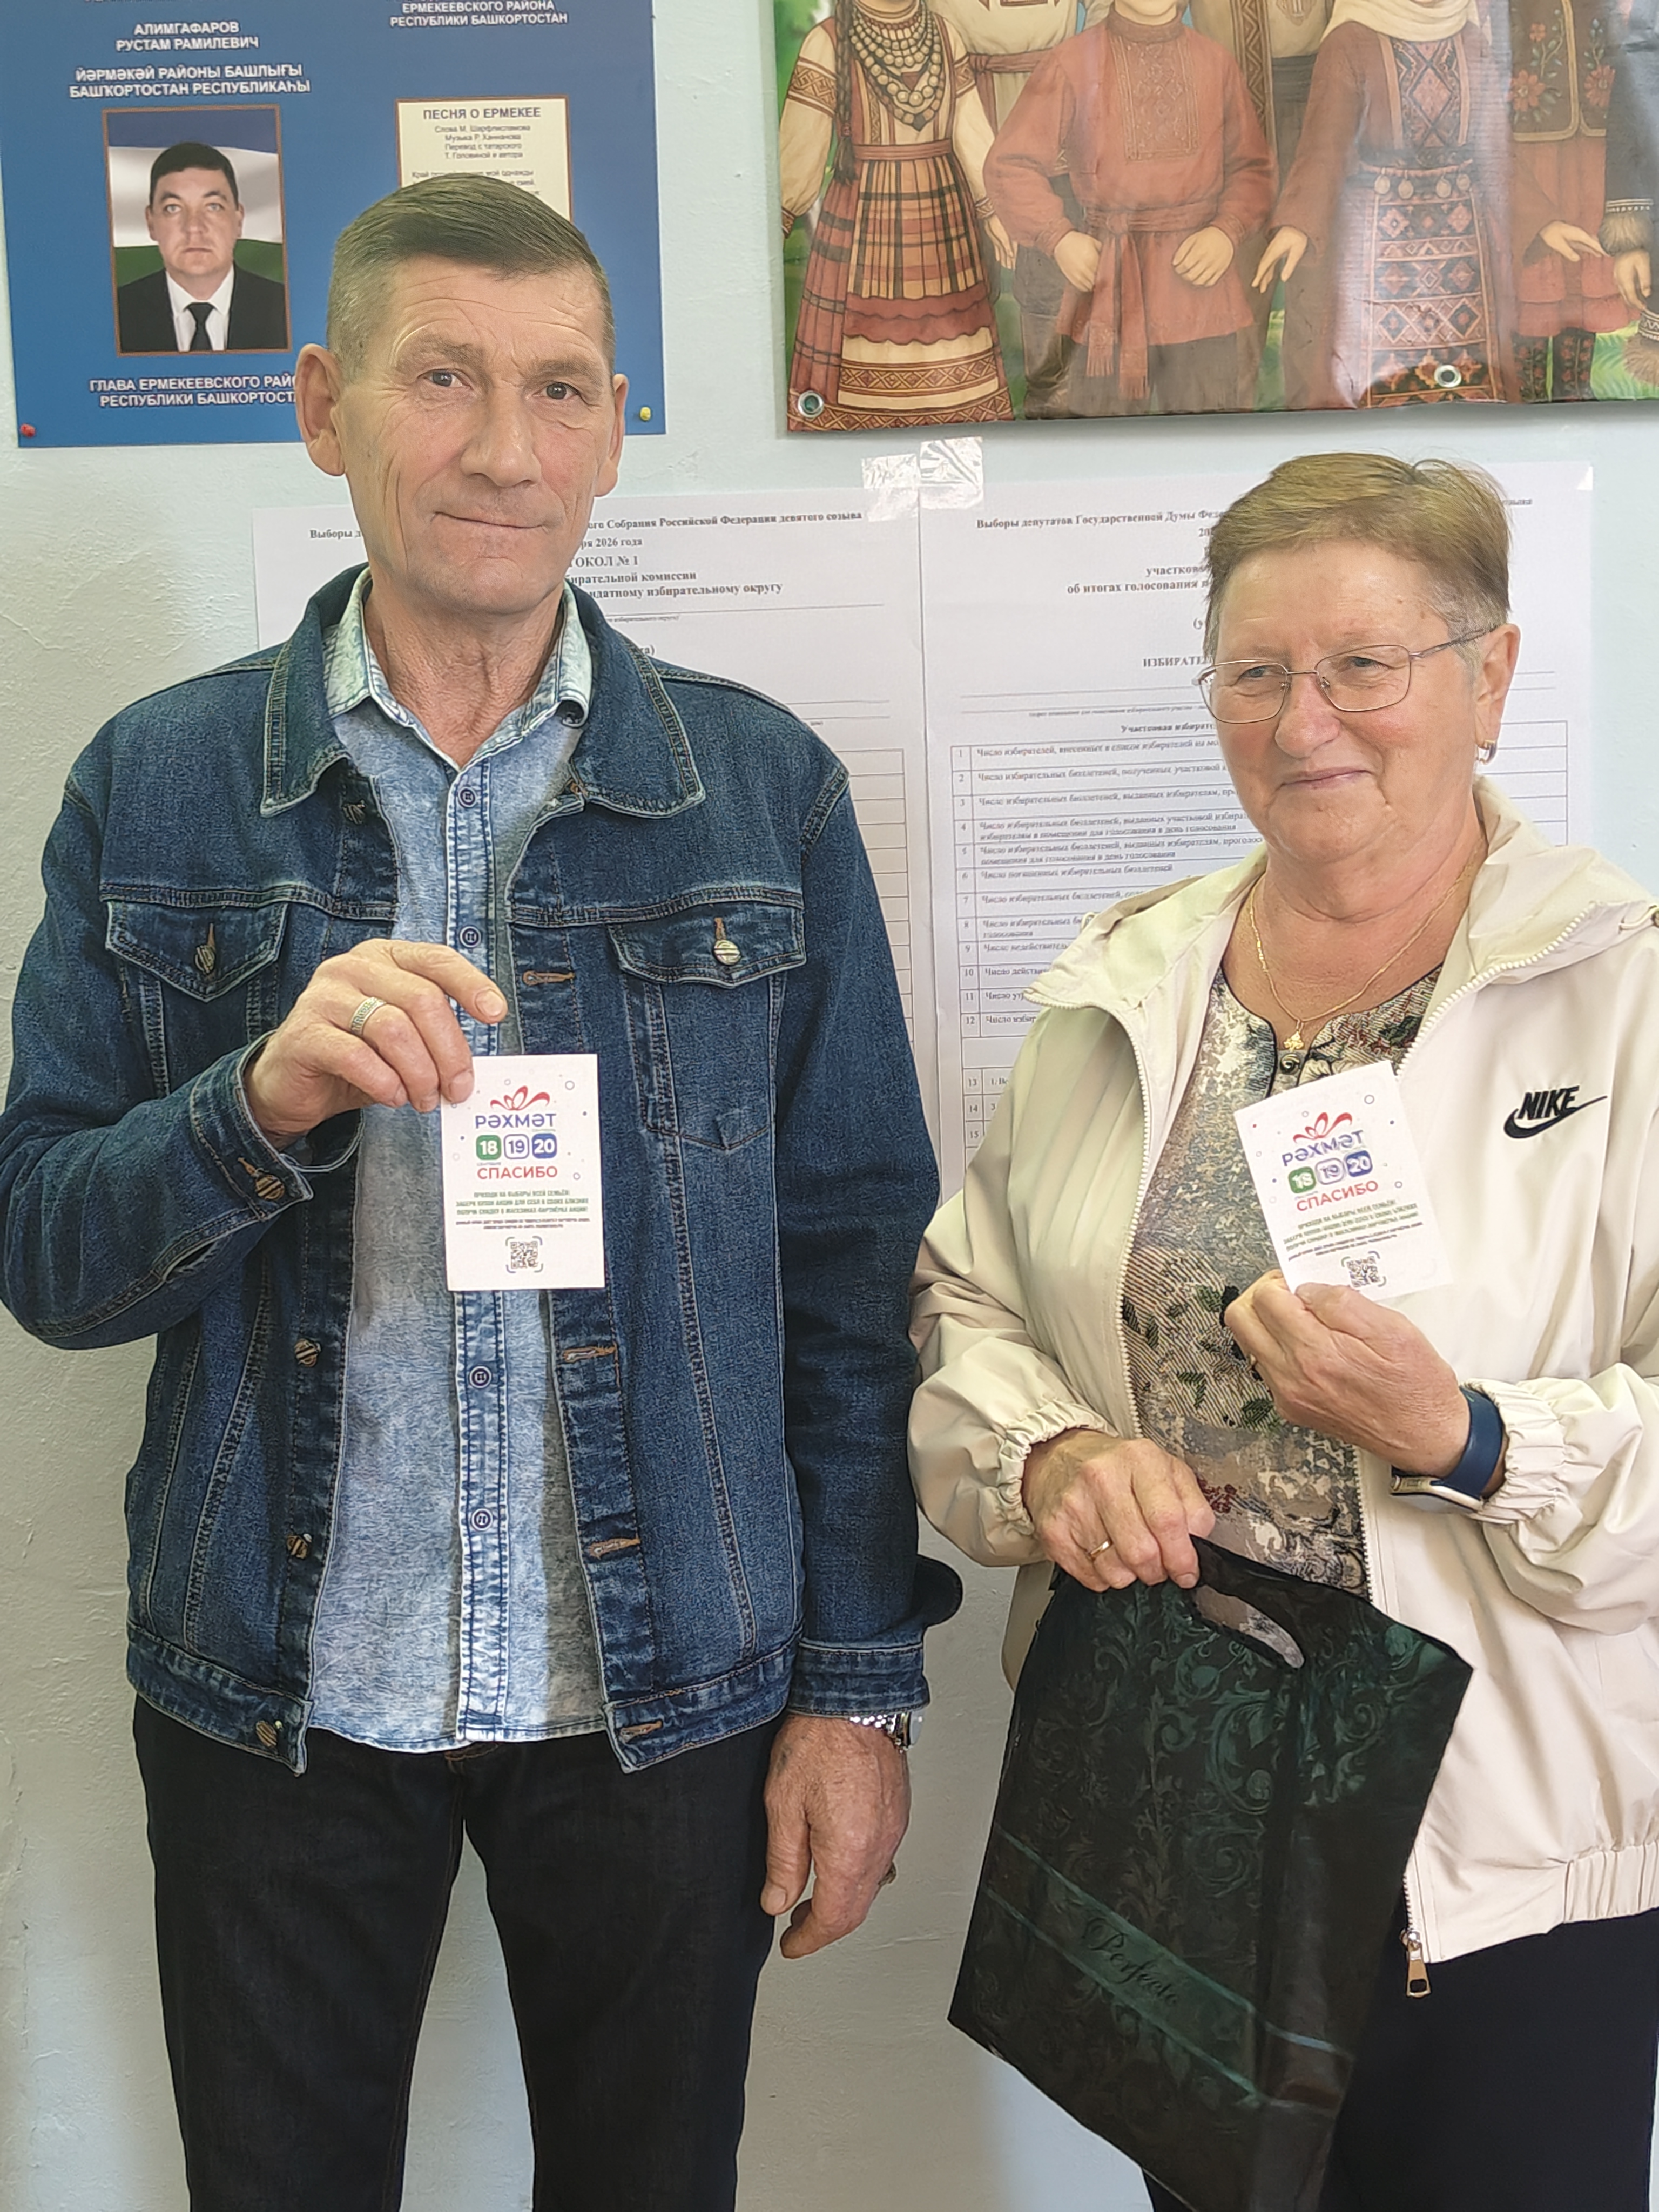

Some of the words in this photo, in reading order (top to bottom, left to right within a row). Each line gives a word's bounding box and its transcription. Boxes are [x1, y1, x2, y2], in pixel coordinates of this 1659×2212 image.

[403, 2, 503, 14] ЕРМЕКЕЕВСКОГО
[390, 15, 468, 27] РЕСПУБЛИКИ
[471, 13, 568, 25] БАШКОРТОСТАН
[134, 21, 239, 36] АЛИМГАФАРОВ
[116, 38, 171, 51] РУСТАМ
[174, 37, 259, 50] РАМИЛЕВИЧ
[159, 65, 220, 79] РАЙОНЫ
[423, 109, 467, 120] ПЕСНЯ
[470, 109, 480, 118] О
[483, 107, 541, 118] ЕРМЕКЕЕ
[89, 380, 136, 392] ГЛАВА
[139, 376, 260, 390] ЕРМЕКЕЕВСКОГО
[100, 393, 194, 407] РЕСПУБЛИКИ
[606, 520, 656, 530] Собрания
[659, 516, 717, 527] Российской
[720, 515, 777, 526] Федерации
[779, 514, 824, 523] девятого
[826, 512, 862, 521] созыва
[976, 518, 1020, 529] Выборы
[1021, 517, 1073, 528] депутатов
[1076, 512, 1163, 525] Государственной
[1165, 511, 1196, 523] Думы
[310, 529, 353, 539] Выборы
[596, 537, 618, 547] 2026
[621, 538, 643, 547] года
[616, 555, 630, 567] №
[633, 556, 638, 565] 1
[641, 572, 697, 582] комиссии
[646, 584, 739, 598] избирательному
[743, 584, 783, 595] округу
[1068, 584, 1080, 594] об
[1083, 584, 1122, 594] итогах
[1125, 581, 1198, 592] голосования
[976, 748, 1003, 756] Число
[958, 774, 965, 783] 2
[978, 773, 1003, 781] Число
[961, 823, 966, 831] 4
[965, 968, 974, 977] 10
[965, 992, 974, 1001] 11
[986, 992, 1010, 1000] Число
[966, 1016, 975, 1025] 12
[986, 1015, 1011, 1023] Число
[968, 1078, 977, 1087] 13
[969, 1104, 978, 1113] 14
[1515, 1085, 1580, 1120] NIKE
[475, 1113, 557, 1129] РӘХМӘТ
[970, 1130, 980, 1139] 15
[479, 1139, 498, 1155] 18
[508, 1139, 525, 1154] 19
[533, 1138, 556, 1154] 20
[1282, 1129, 1364, 1167] РӘХМӘТ
[477, 1165, 558, 1180] СПАСИБО
[1291, 1172, 1314, 1189] 18
[1319, 1164, 1340, 1179] 19
[1346, 1155, 1372, 1174] 20
[1297, 1181, 1379, 1211] СПАСИБО
